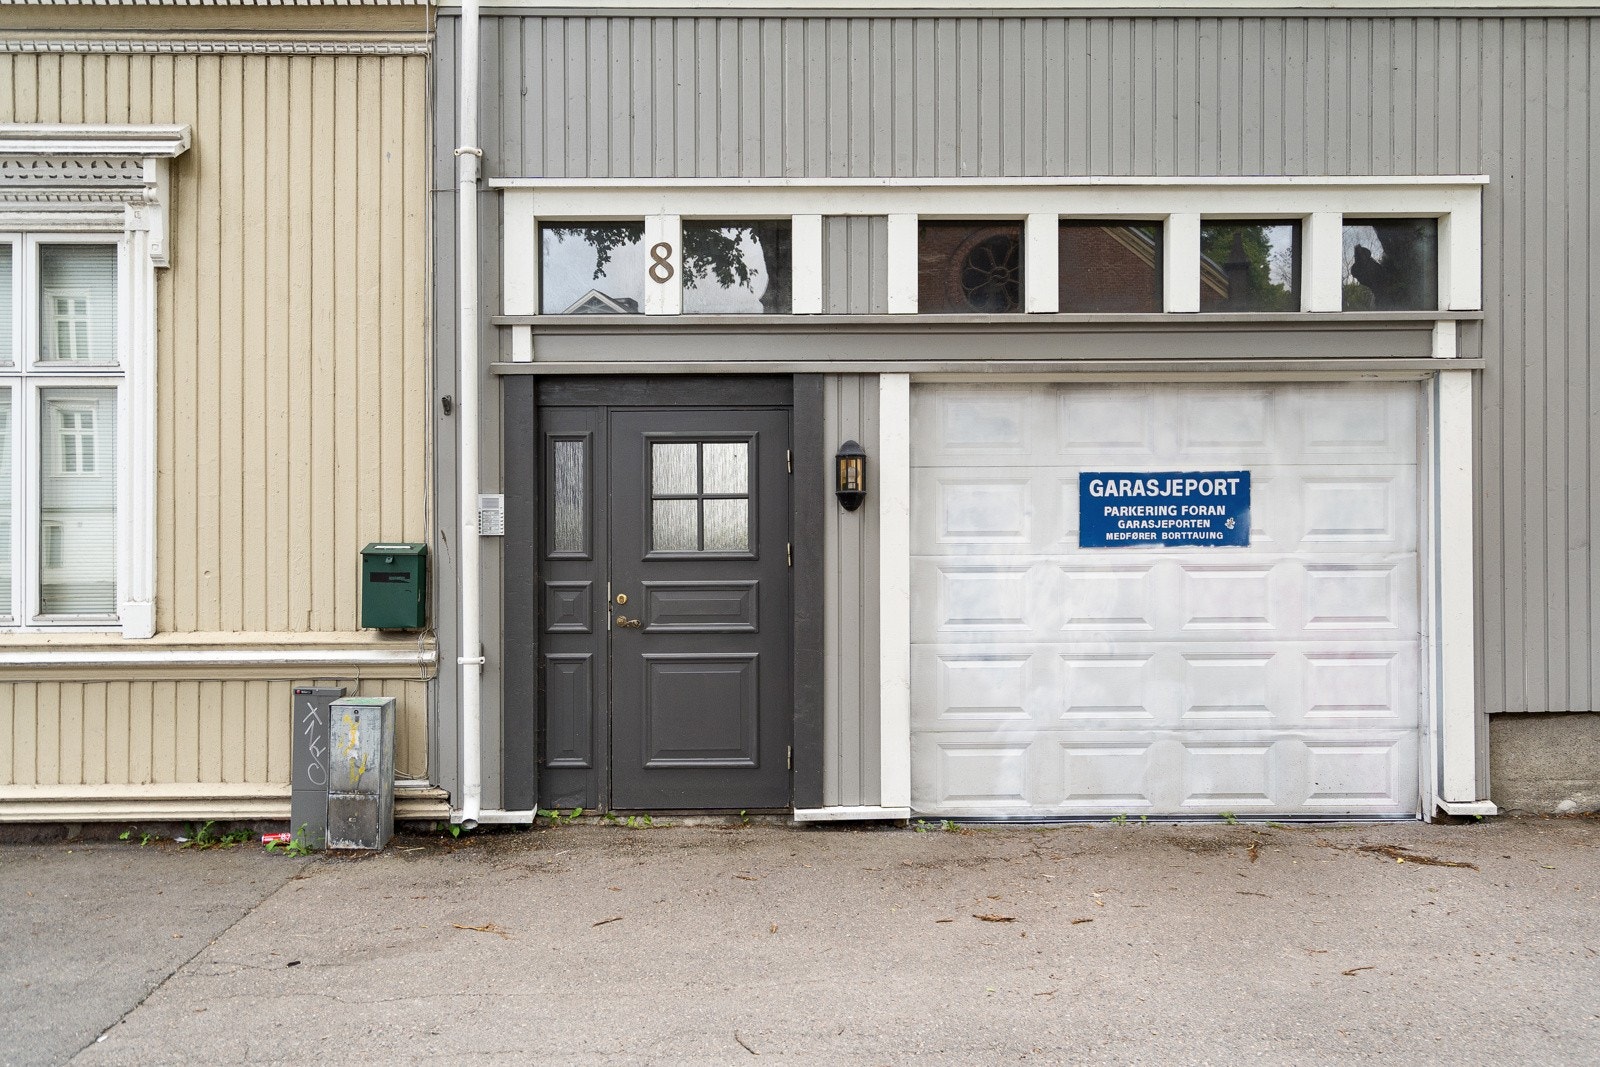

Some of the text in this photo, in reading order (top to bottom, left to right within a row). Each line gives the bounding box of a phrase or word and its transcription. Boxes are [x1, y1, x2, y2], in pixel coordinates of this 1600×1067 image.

[649, 242, 674, 283] 8
[1089, 479, 1240, 497] GARASJEPORT
[1104, 505, 1226, 517] PARKERING FORAN
[1118, 519, 1211, 529] GARASJEPORTEN
[1106, 532, 1224, 540] MEDFØRER BORTTAUING
